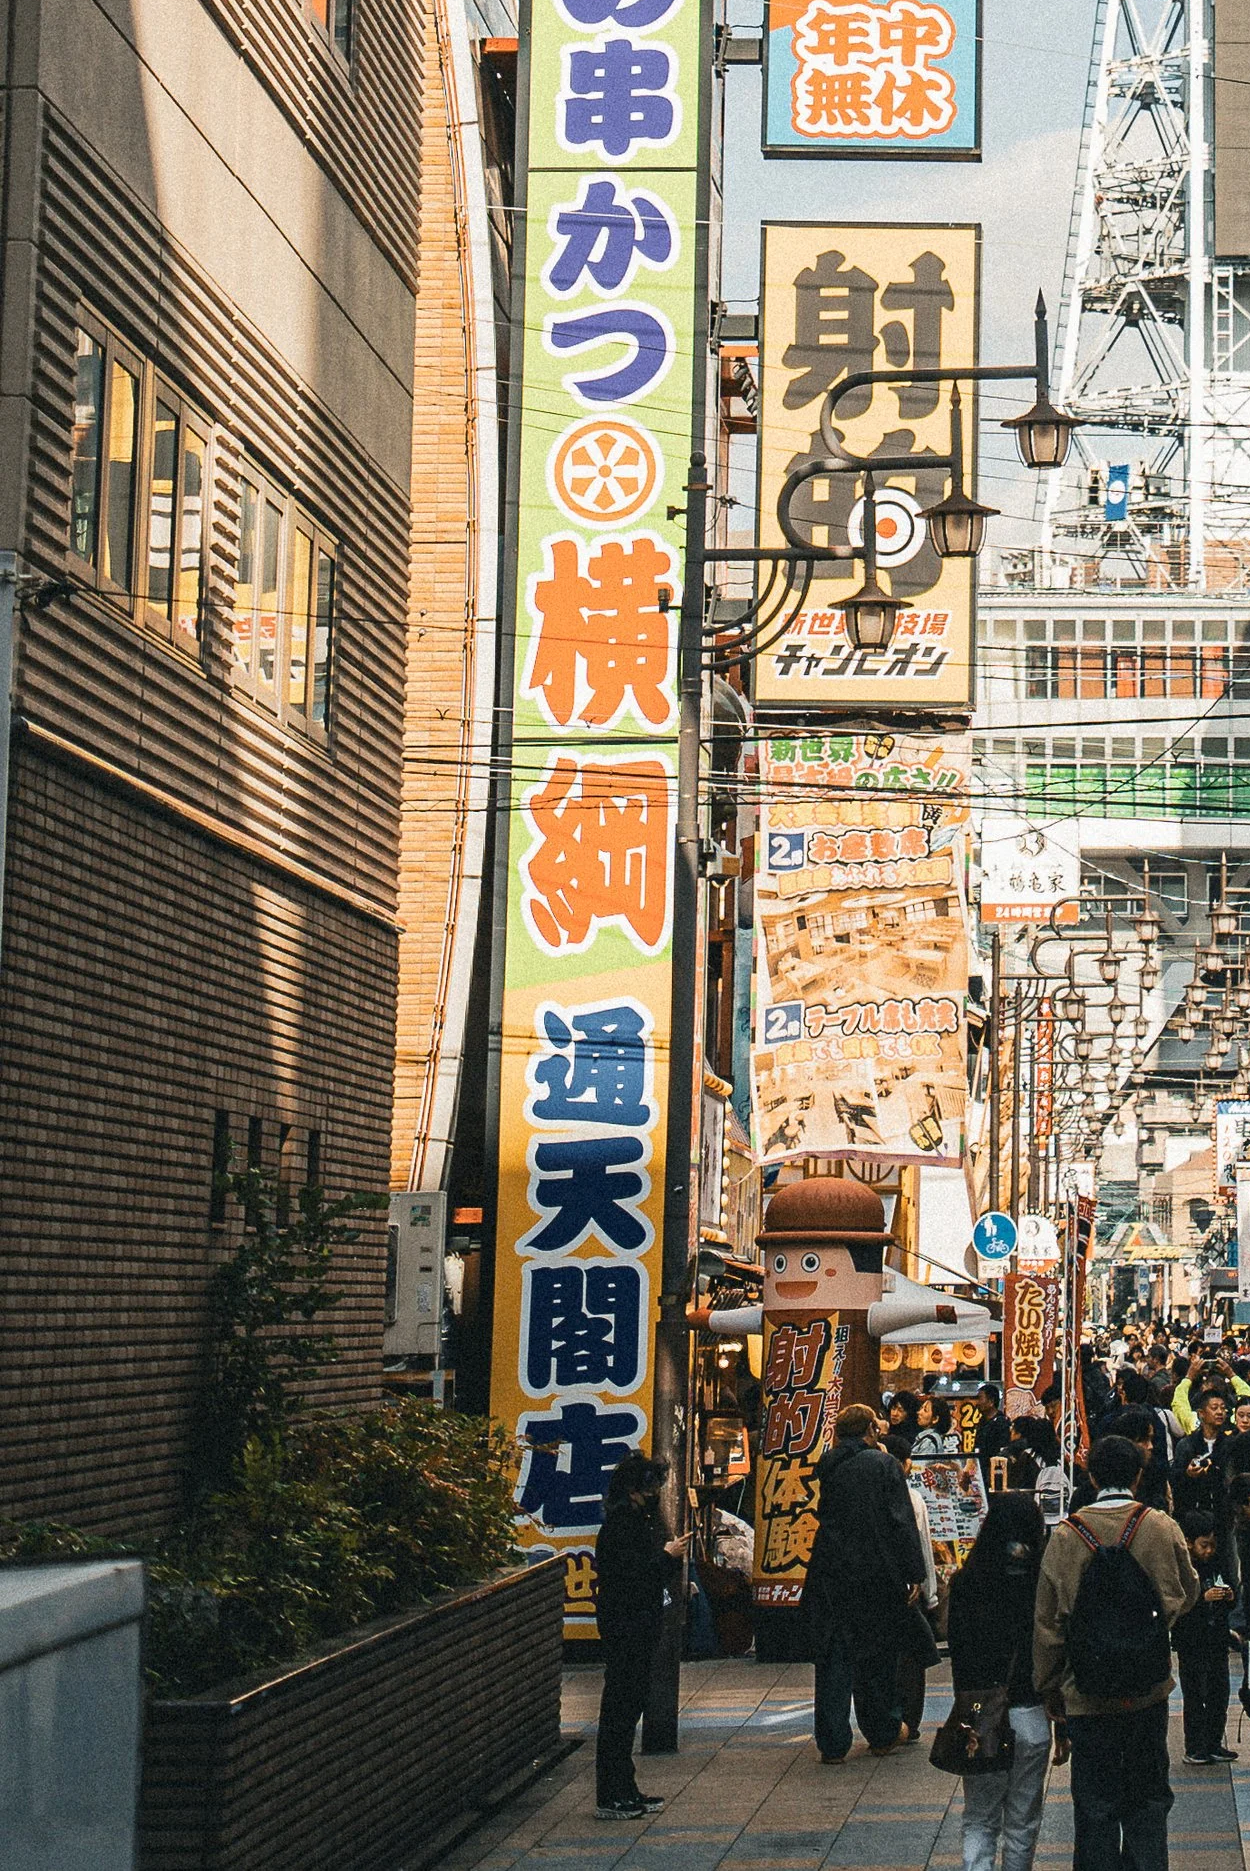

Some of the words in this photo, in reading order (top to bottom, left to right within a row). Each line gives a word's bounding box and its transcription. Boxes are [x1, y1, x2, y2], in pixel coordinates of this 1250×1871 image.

[806, 6, 946, 68] 年中
[804, 70, 944, 128] 無休
[782, 249, 955, 599] 射的
[781, 612, 949, 637] 新世技場
[528, 537, 675, 947] 横綱
[770, 736, 856, 763] 新世界
[517, 1005, 651, 1529] 通天閣店
[1014, 1280, 1044, 1386] たい焼き
[763, 1322, 825, 1568] 射的体験
